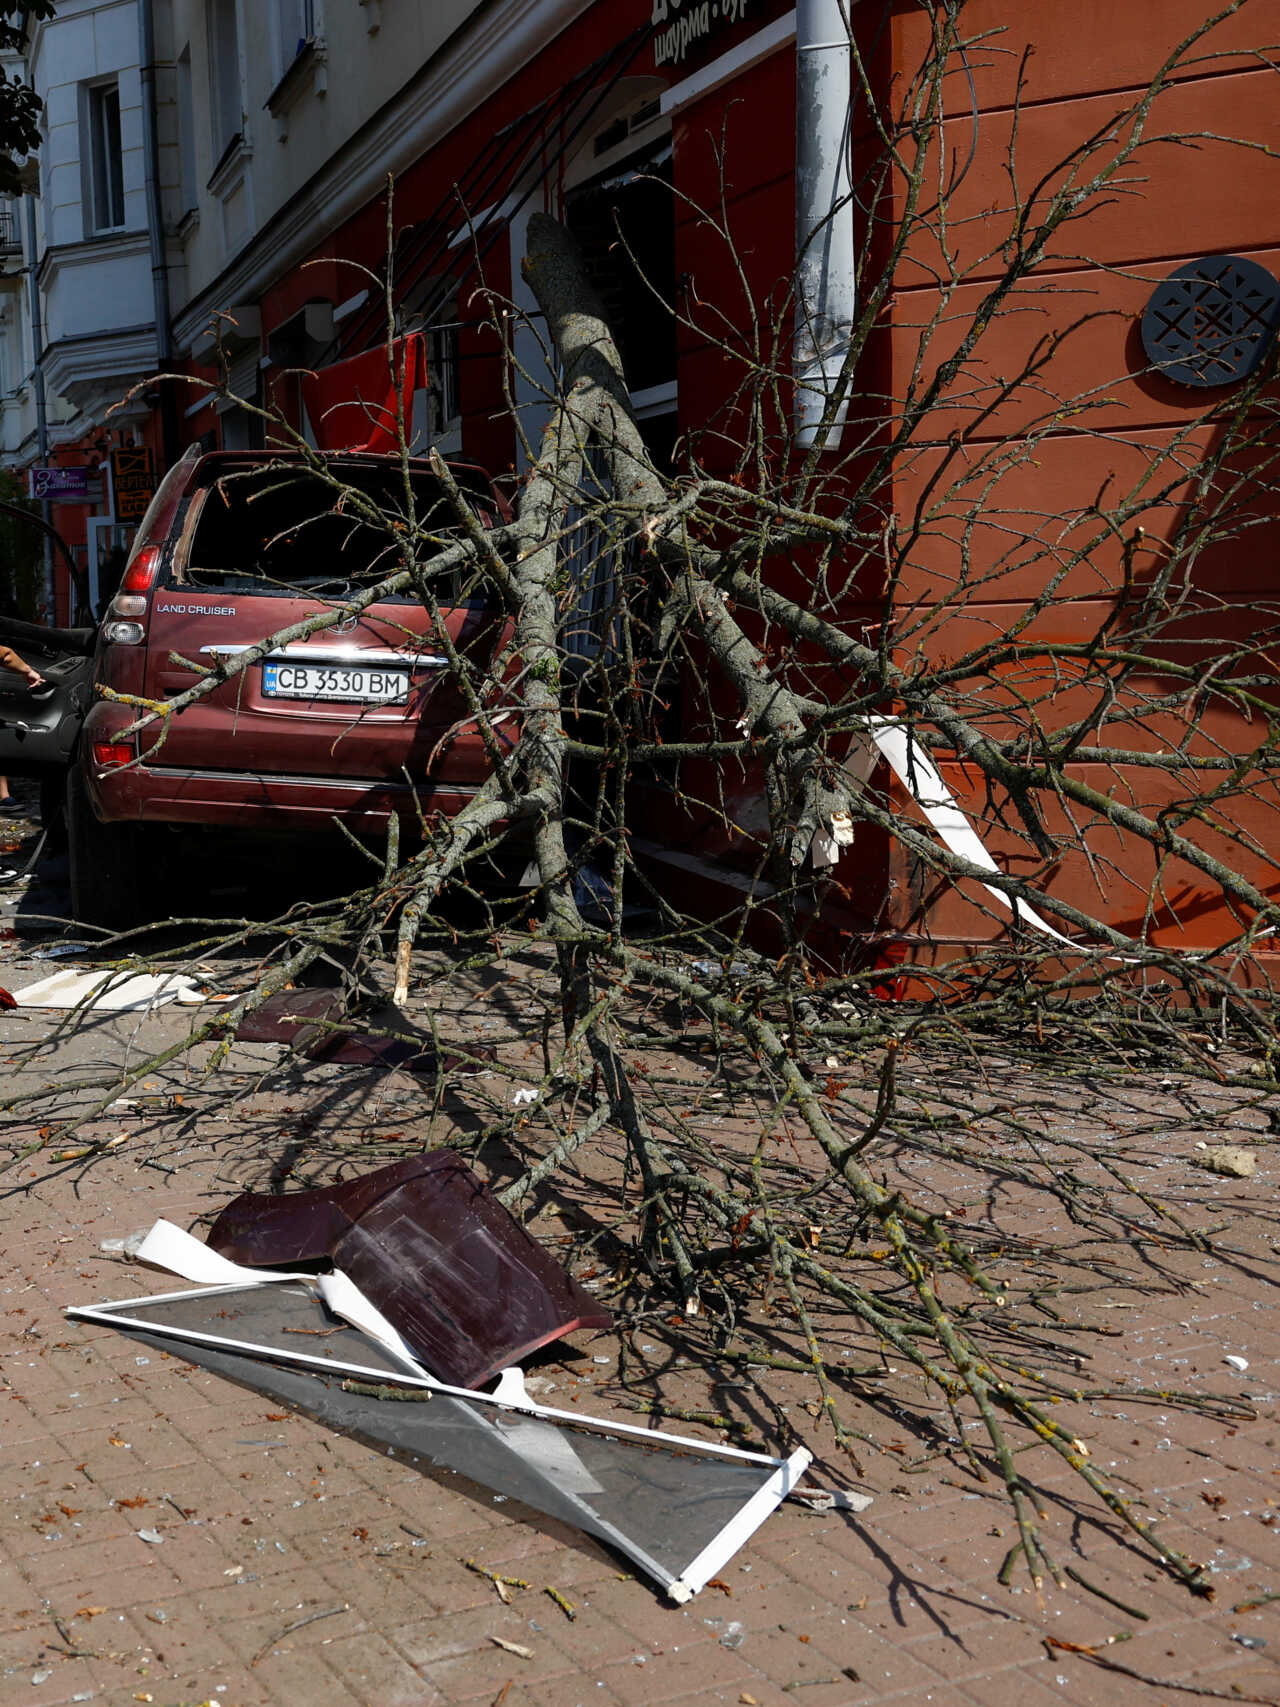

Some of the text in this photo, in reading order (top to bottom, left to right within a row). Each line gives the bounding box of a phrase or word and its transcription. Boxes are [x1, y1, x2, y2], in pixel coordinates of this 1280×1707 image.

[654, 1, 710, 67] шаурма
[156, 604, 236, 616] LAND CRUISER
[278, 668, 400, 694] CB 3530 BM
